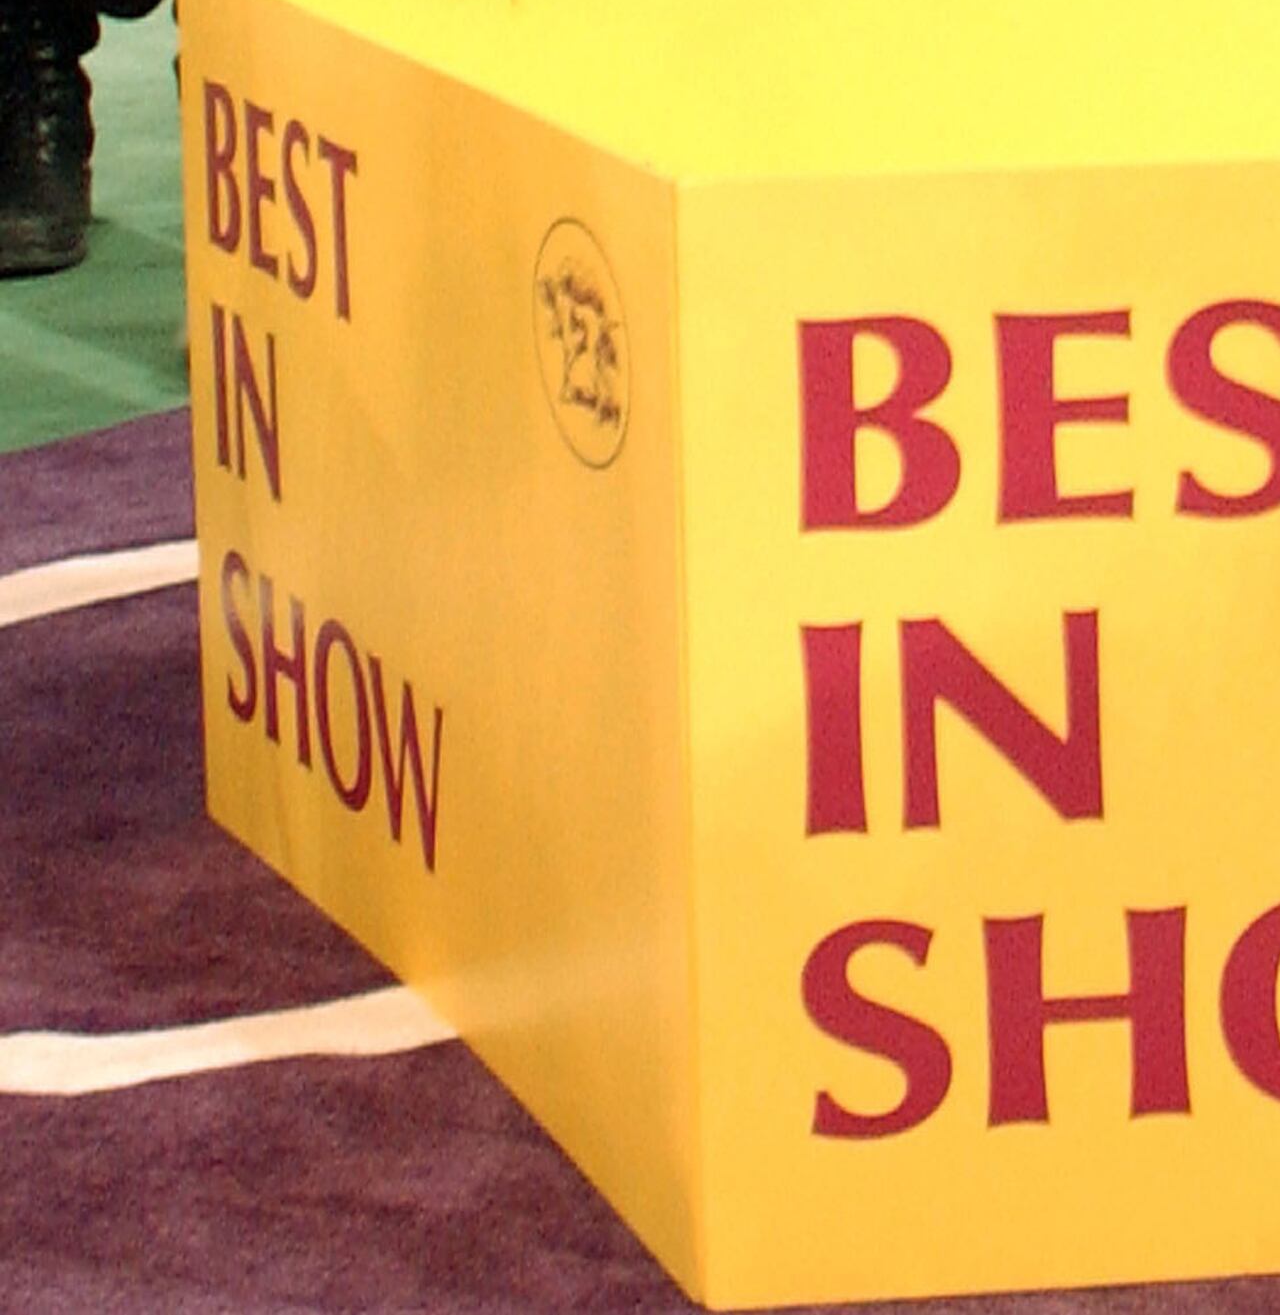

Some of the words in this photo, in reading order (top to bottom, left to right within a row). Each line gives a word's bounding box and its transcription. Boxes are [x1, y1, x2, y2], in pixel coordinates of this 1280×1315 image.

[203, 78, 359, 324] BEST
[210, 302, 282, 504] IN
[219, 549, 445, 874] SHOW
[800, 608, 1105, 838] IN
